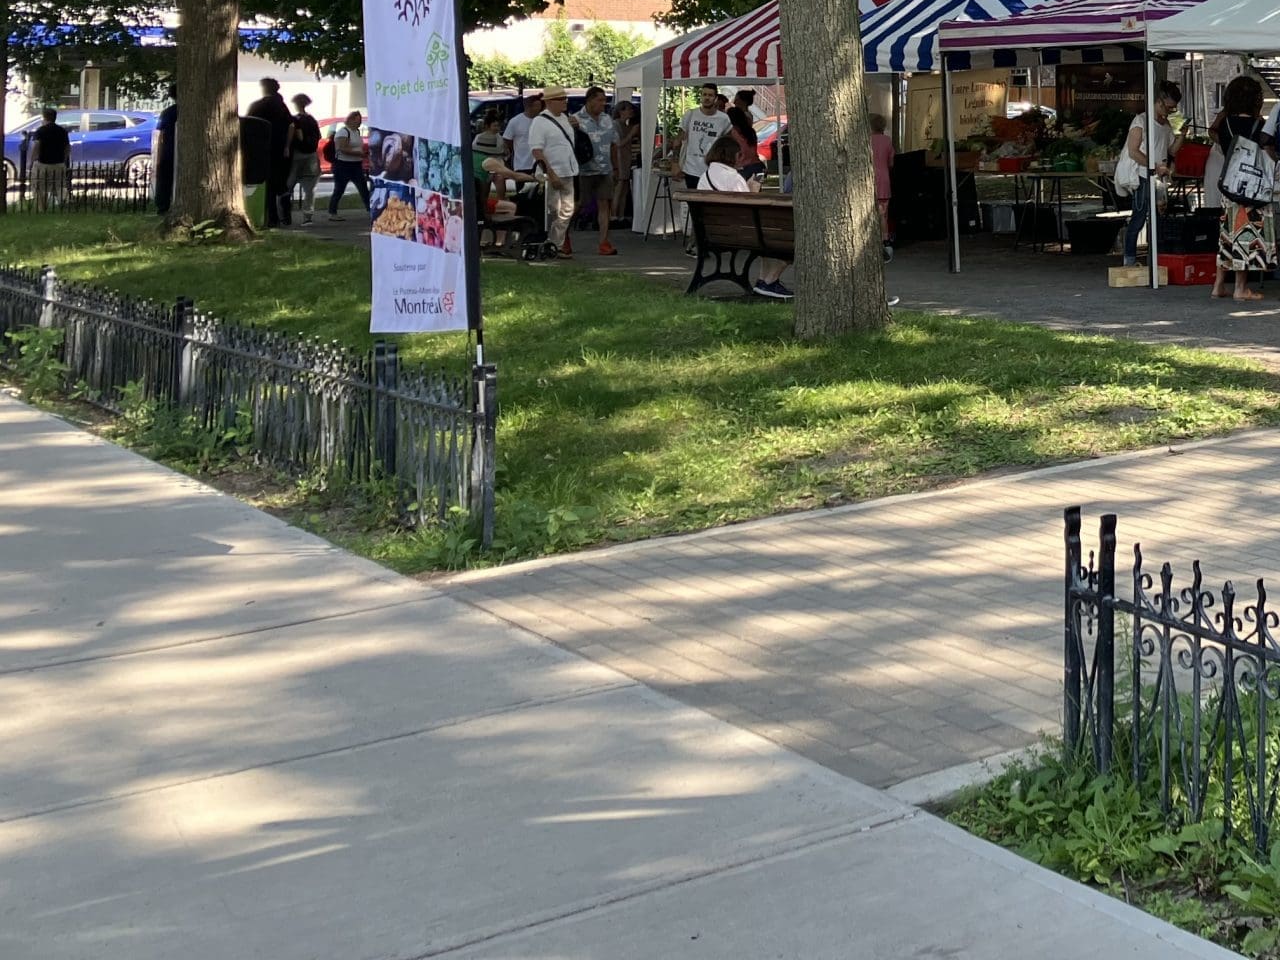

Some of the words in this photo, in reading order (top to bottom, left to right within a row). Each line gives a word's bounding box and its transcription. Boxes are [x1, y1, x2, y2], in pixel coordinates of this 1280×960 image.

[375, 81, 411, 100] Projet
[413, 76, 424, 90] de
[394, 296, 443, 315] Montréal
